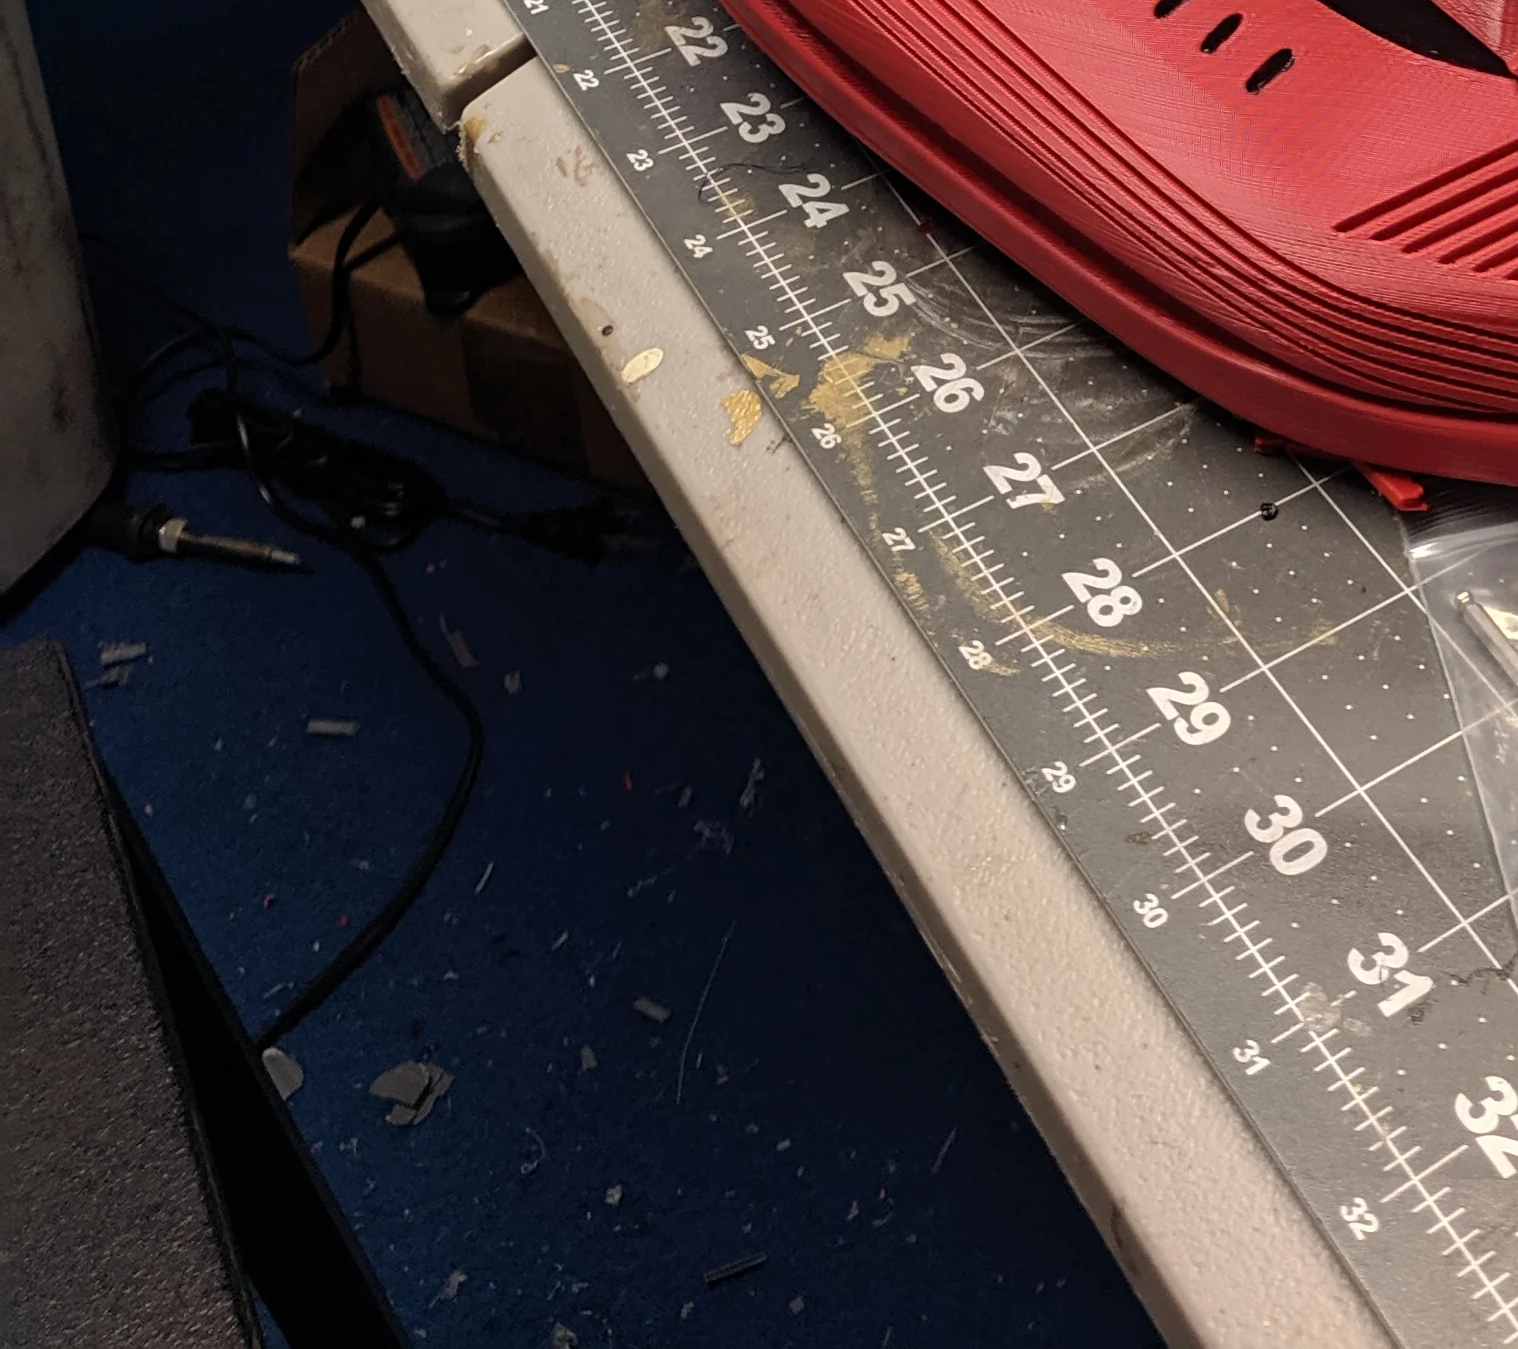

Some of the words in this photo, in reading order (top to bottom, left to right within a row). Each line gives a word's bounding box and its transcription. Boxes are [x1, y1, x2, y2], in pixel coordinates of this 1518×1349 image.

[572, 67, 600, 92] 22
[625, 148, 655, 173] 23
[683, 234, 713, 259] 24
[744, 324, 775, 351] 25
[811, 422, 842, 450] 26
[881, 526, 916, 554] 27
[958, 639, 993, 671] 28
[1040, 760, 1076, 794] 29
[1132, 893, 1169, 929] 30
[1231, 1039, 1272, 1076] 31
[1339, 1197, 1380, 1240] 32
[665, 16, 728, 67] 22
[720, 92, 786, 144] 23
[778, 173, 849, 229] 24
[842, 260, 917, 317] 25
[910, 352, 985, 413] 26
[983, 451, 1065, 510] 27
[1061, 557, 1143, 628] 28
[1146, 671, 1231, 745] 29
[1244, 794, 1328, 876] 30
[1347, 932, 1434, 1018] 31
